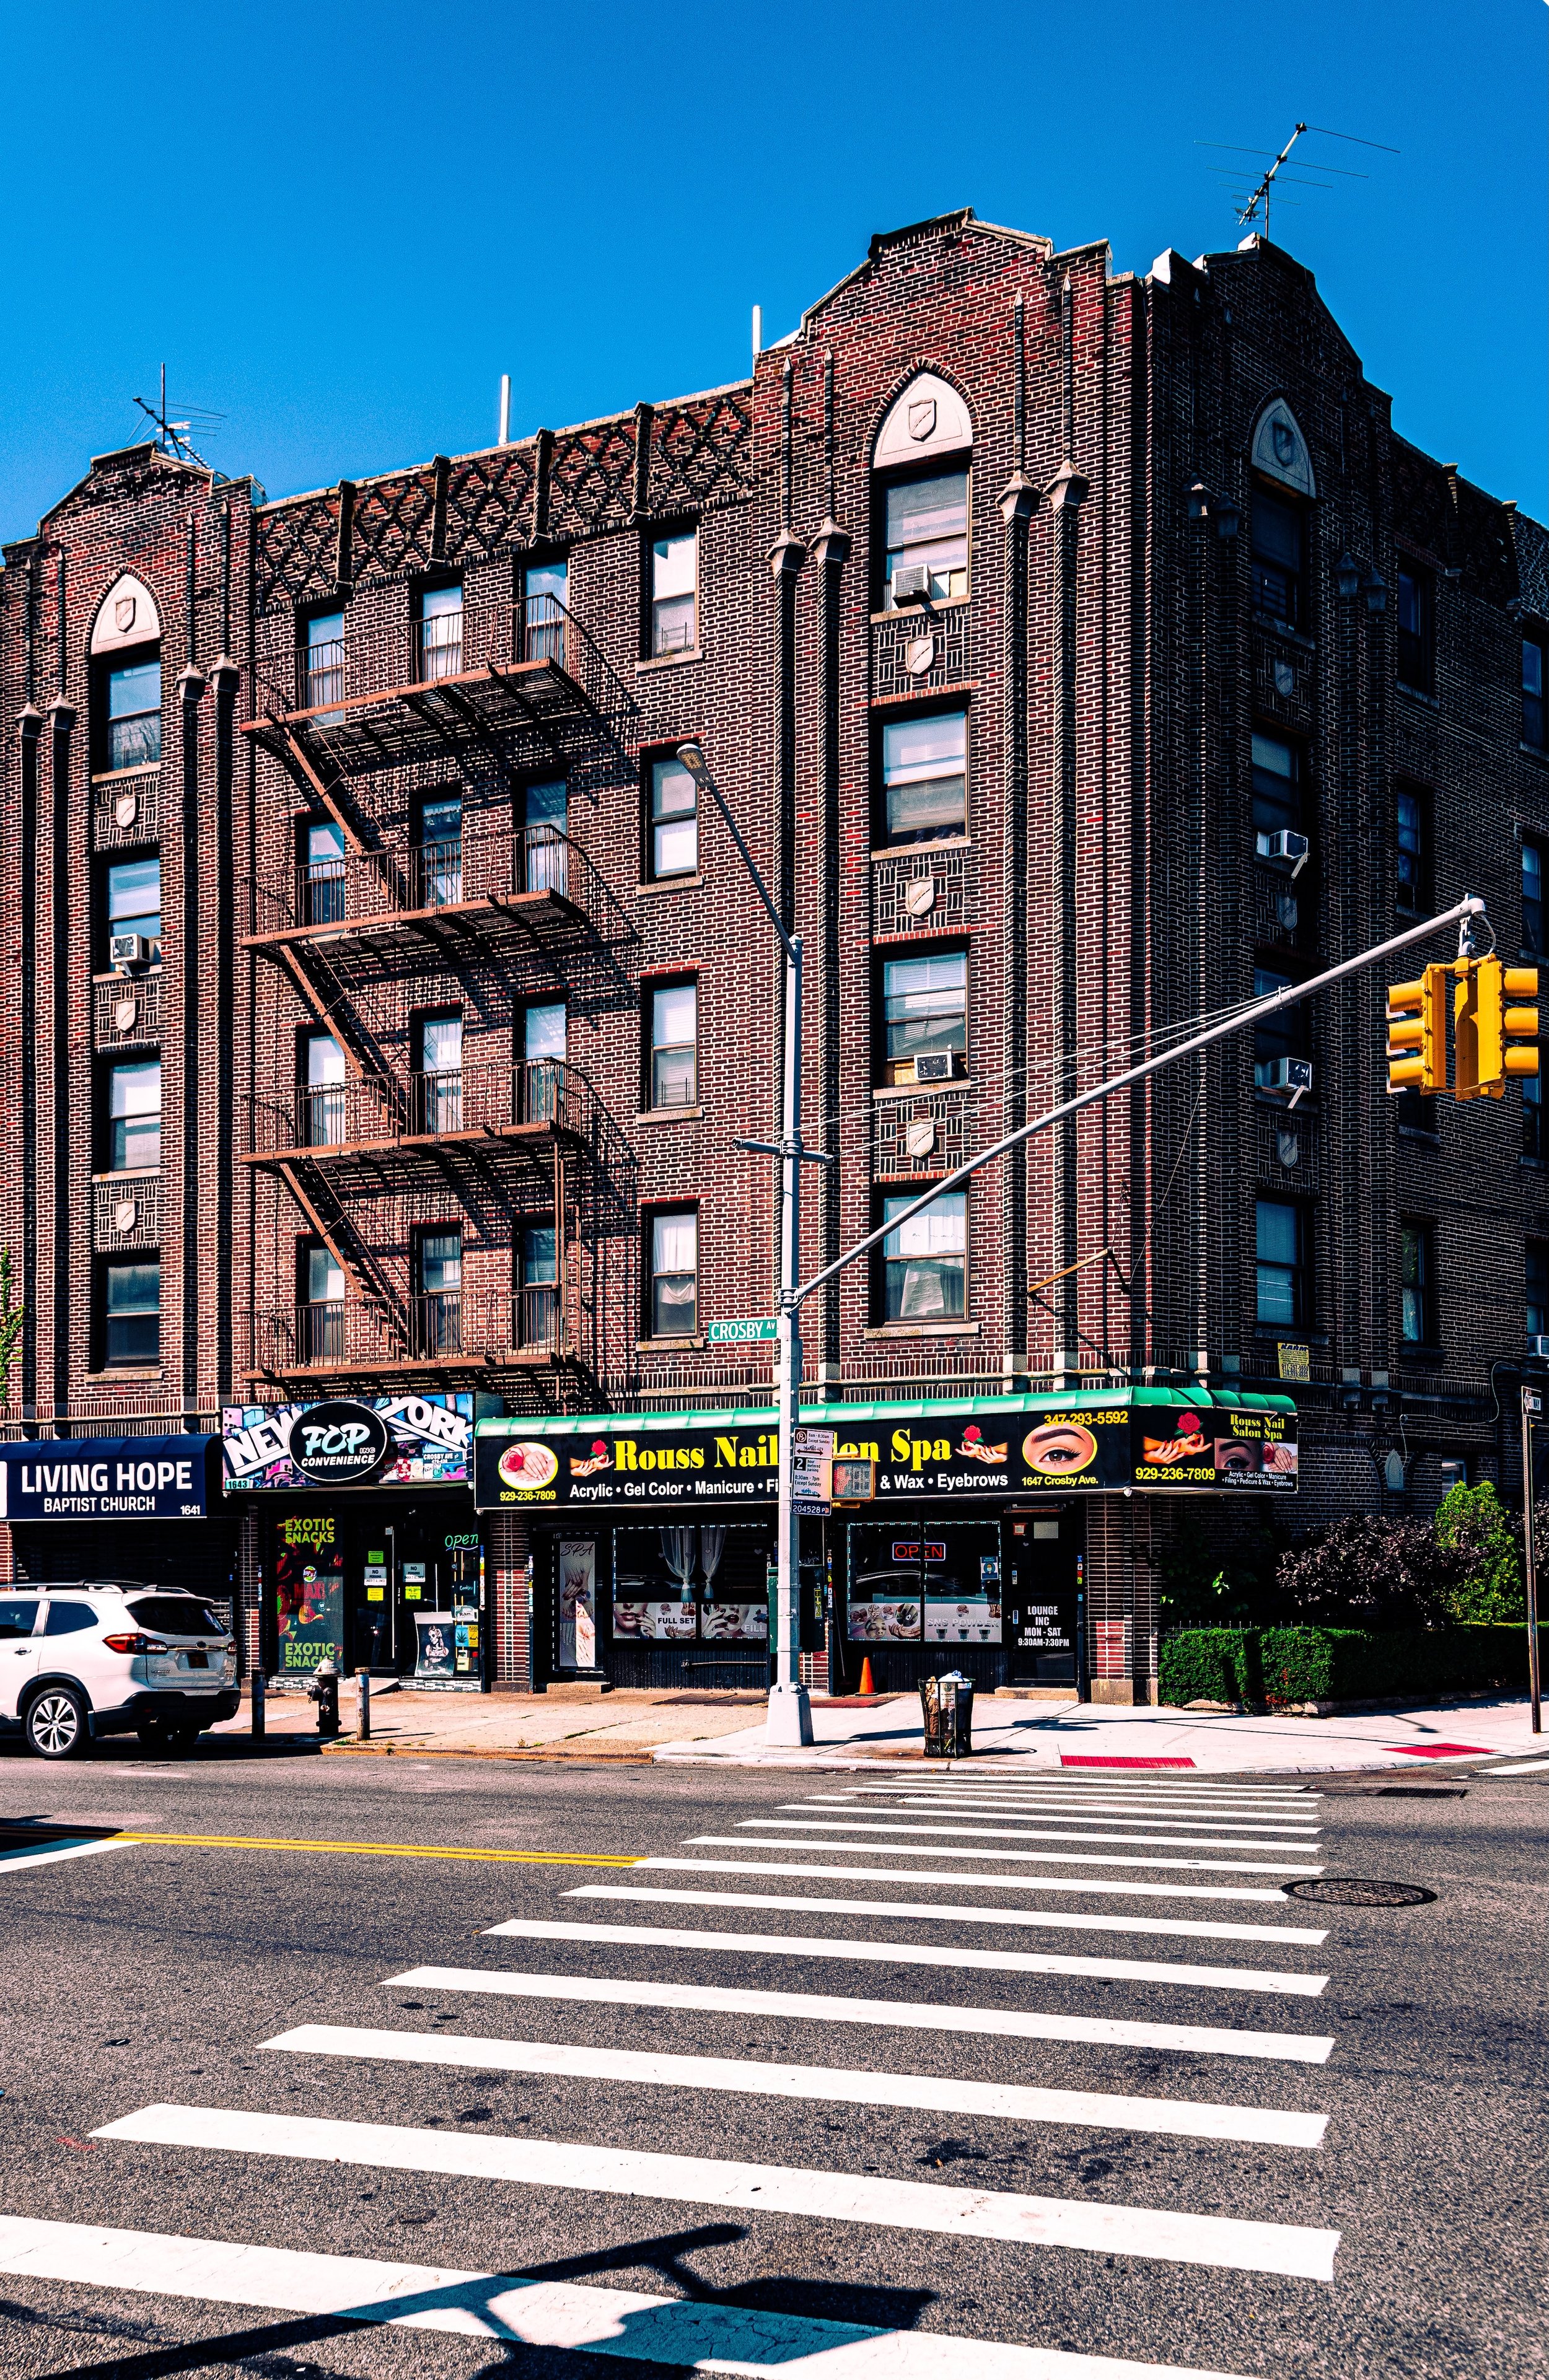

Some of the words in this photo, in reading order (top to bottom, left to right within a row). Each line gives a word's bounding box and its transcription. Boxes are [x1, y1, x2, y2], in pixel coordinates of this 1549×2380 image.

[711, 1321, 763, 1340] CROSBY
[373, 1396, 473, 1448] YORK
[1044, 1411, 1128, 1426] 347-293-5592
[1230, 1414, 1261, 1427] Rouss
[1264, 1417, 1284, 1428] Nail
[223, 1405, 304, 1469] NEW
[1232, 1425, 1261, 1438] Salon
[1264, 1428, 1283, 1442] Spa
[613, 1440, 704, 1471] Rouss
[714, 1435, 779, 1468] Nail
[891, 1428, 952, 1471] Spa
[301, 1454, 375, 1467] CONVENIENCE
[796, 1458, 803, 1469] 2
[22, 1463, 108, 1492] LIVING
[116, 1461, 192, 1490] HOPE
[1135, 1467, 1215, 1480] 929-236-7809
[228, 1480, 247, 1489] 1643
[880, 1476, 890, 1489] &
[894, 1475, 924, 1489] Wax
[937, 1473, 1008, 1491] Eyebrows
[1022, 1477, 1043, 1486] 1647
[1044, 1476, 1077, 1487] Crosby
[1078, 1476, 1099, 1484] Ave.
[500, 1490, 556, 1502] 929-236-7809
[569, 1484, 613, 1500] Acrylic
[625, 1482, 645, 1496] Gel
[649, 1482, 683, 1495] Color
[695, 1480, 754, 1494] Manicure
[44, 1497, 97, 1512] BAPTIST
[101, 1496, 155, 1511] CHURCH
[180, 1505, 200, 1515] 1641
[792, 1505, 820, 1513] 204528
[285, 1518, 335, 1531] EXOTIC
[285, 1531, 335, 1543] SNACKS
[560, 1543, 594, 1556] SPA
[895, 1545, 942, 1558] OPEN
[1028, 1606, 1058, 1615] LOUNGE
[926, 1618, 949, 1627] SNS
[952, 1618, 999, 1627] POWDER
[1035, 1617, 1050, 1625] INC
[1025, 1627, 1042, 1636] MON
[1047, 1627, 1061, 1636] SAT
[285, 1642, 335, 1655] EXOTIC
[1018, 1638, 1069, 1647] 9:30AM-7:30PM
